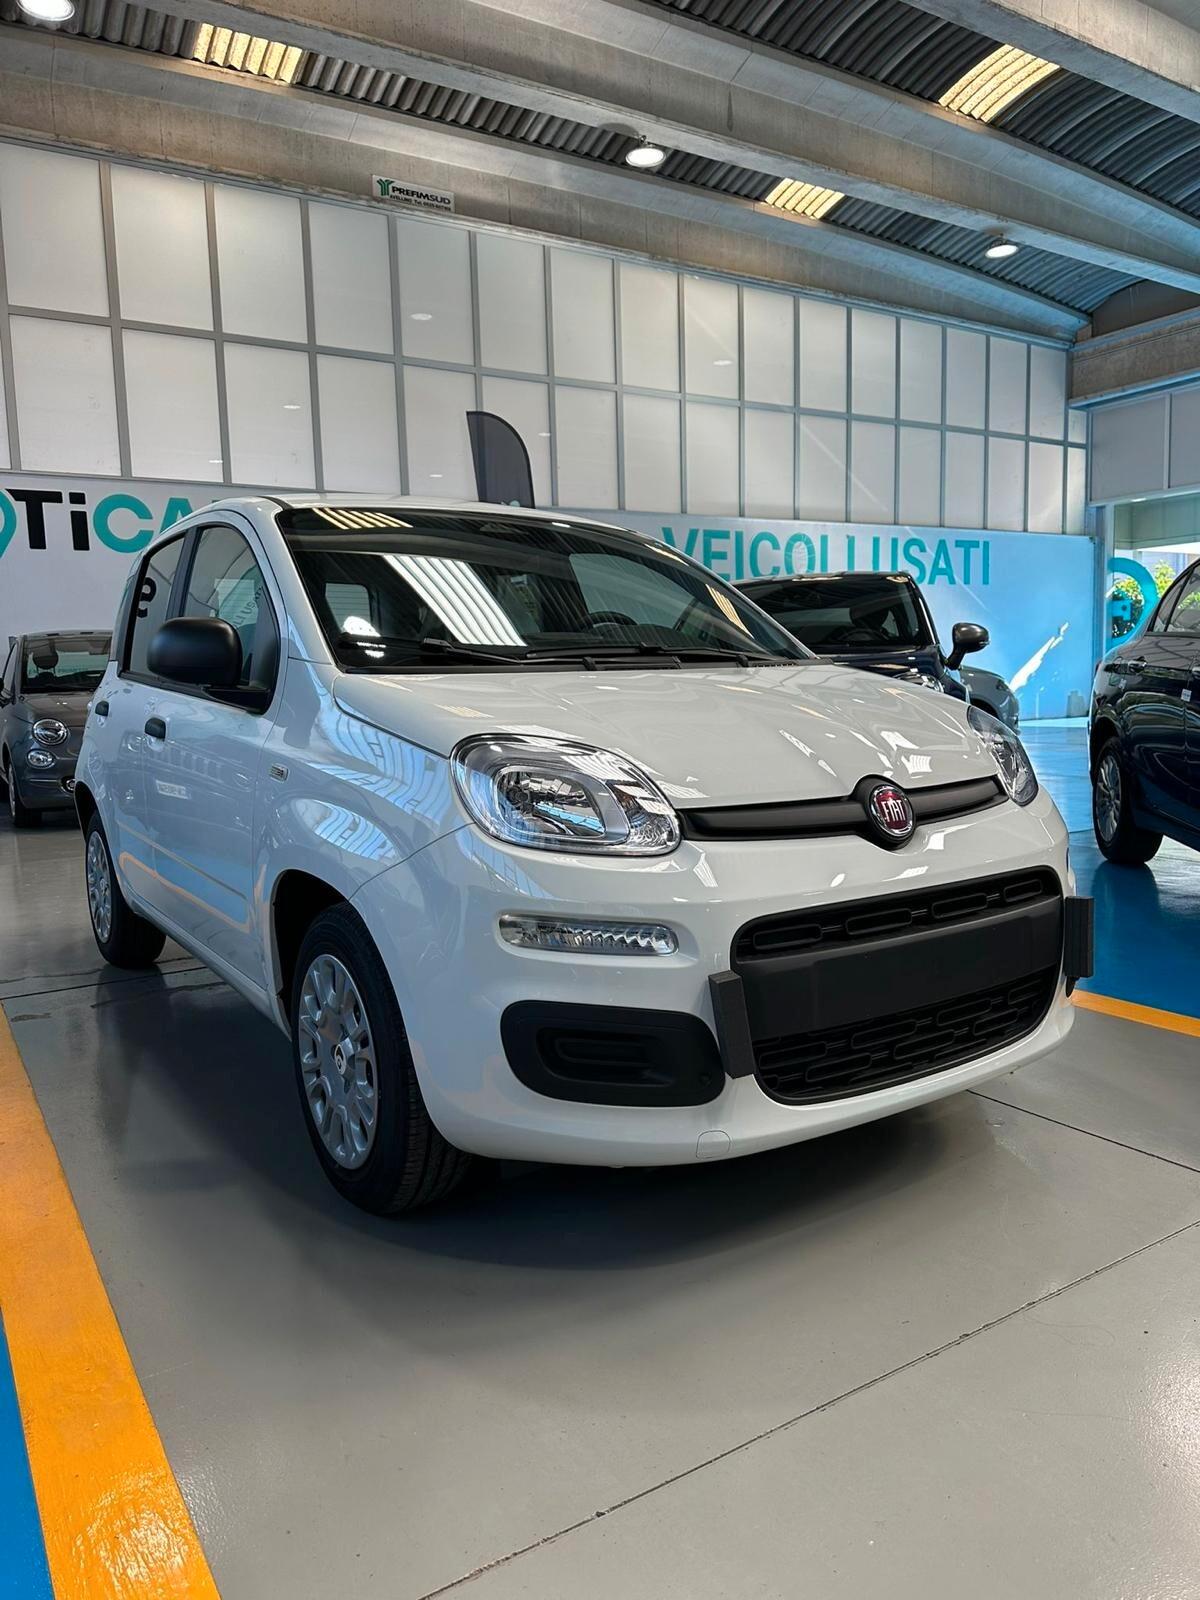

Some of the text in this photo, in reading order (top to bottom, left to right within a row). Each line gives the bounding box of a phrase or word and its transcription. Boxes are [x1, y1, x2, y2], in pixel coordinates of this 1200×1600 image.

[391, 186, 451, 205] PREFIMSUD
[873, 535, 990, 585] USATI
[881, 798, 906, 822] FIAT
